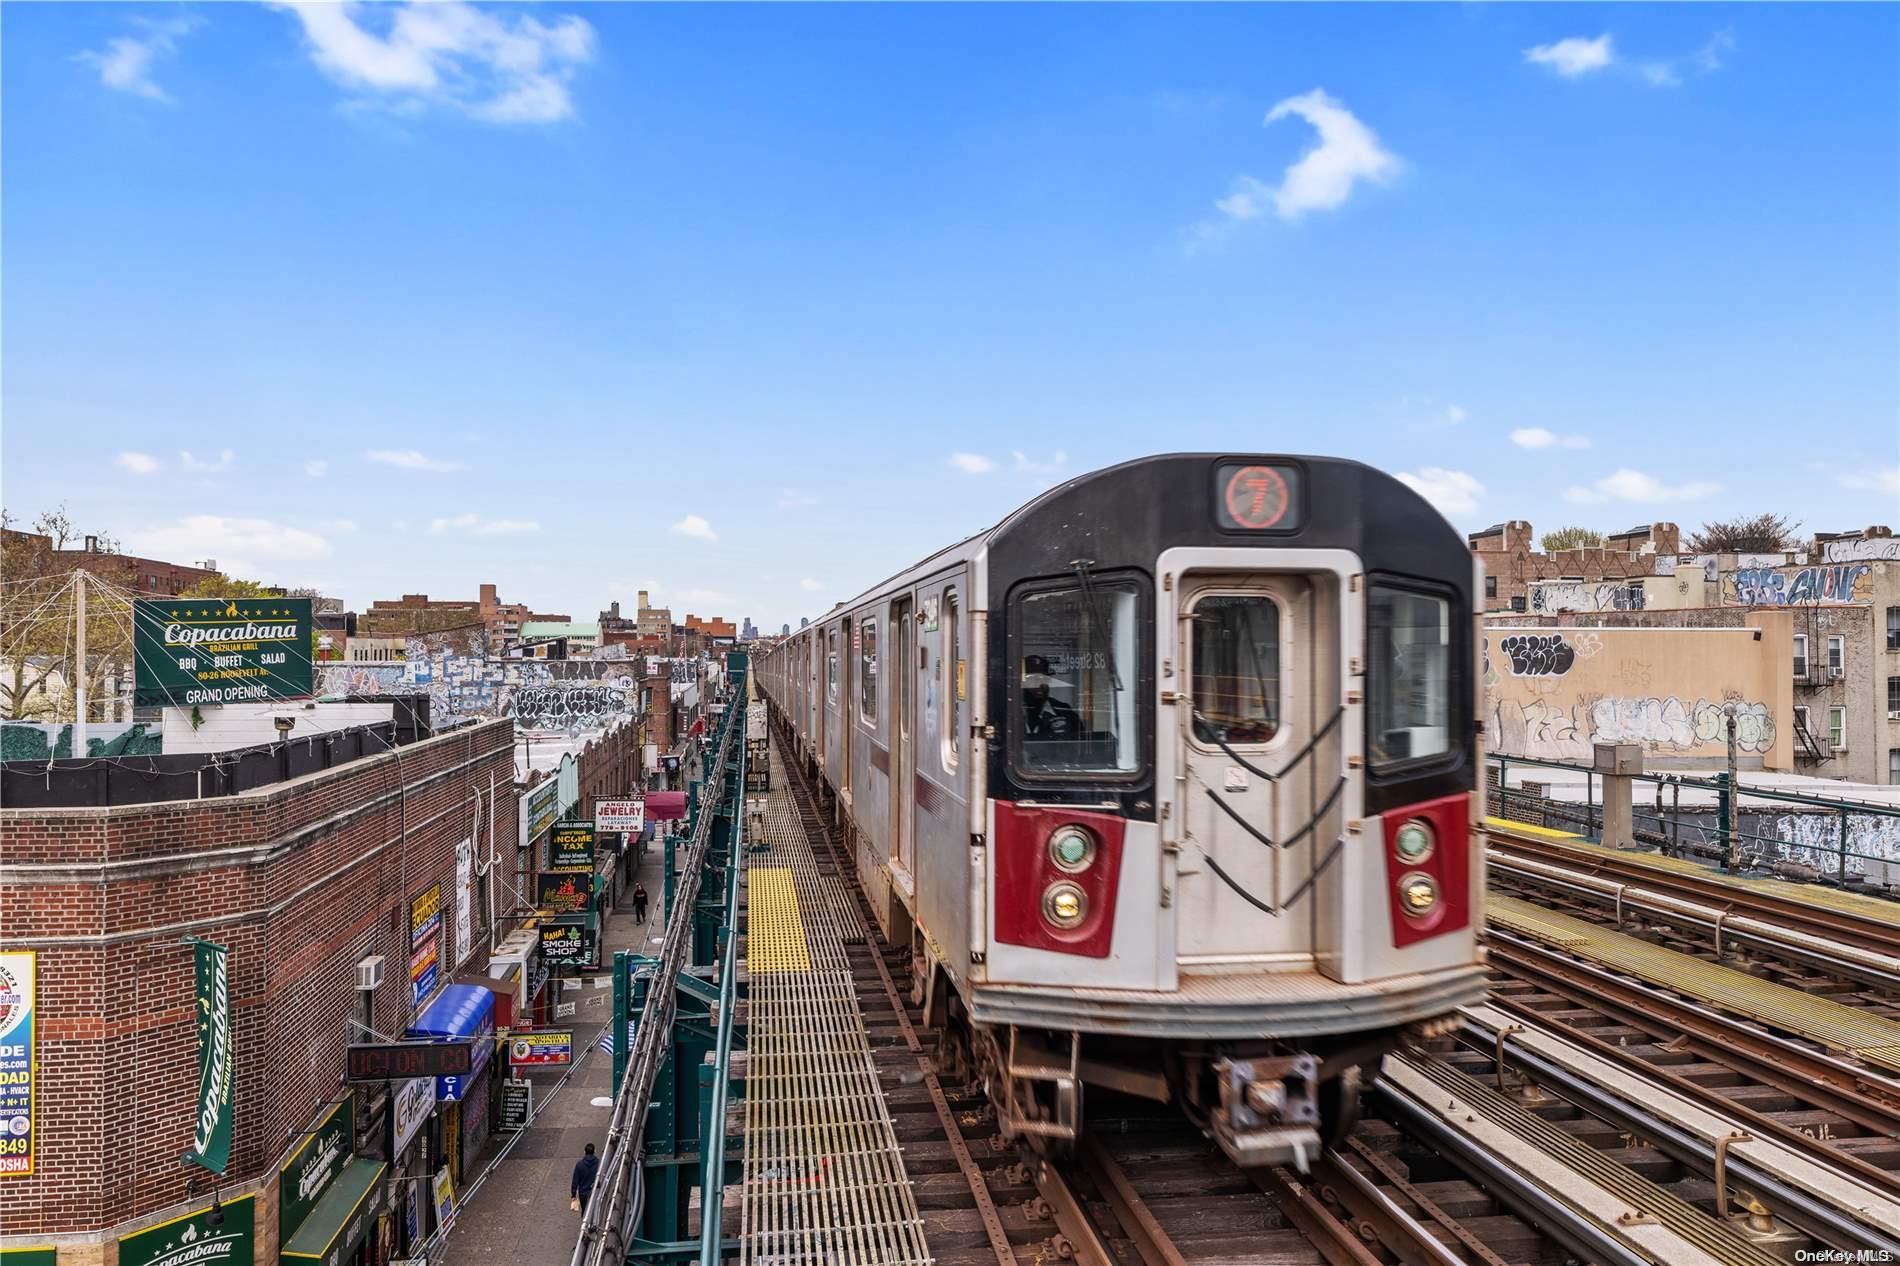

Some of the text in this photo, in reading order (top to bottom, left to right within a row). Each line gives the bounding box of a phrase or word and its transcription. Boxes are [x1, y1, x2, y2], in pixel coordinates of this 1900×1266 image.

[1246, 479, 1269, 515] 7
[164, 622, 297, 648] Copacabana
[179, 652, 286, 670] BBQ BUFFET SALAD
[197, 671, 219, 681] 80-26
[220, 669, 258, 679] ROOSEVELT
[186, 685, 268, 704] GRAND OPENING
[599, 807, 641, 816] JEWELRY
[554, 835, 592, 843] INCOME
[412, 897, 439, 932] ECUADOR
[542, 940, 581, 948] SMOKE
[546, 948, 577, 956] SHOP
[0, 1045, 25, 1057] DE
[194, 950, 227, 1158] Copacabana
[0, 1071, 30, 1085] DAD
[0, 1158, 29, 1171] OSHA
